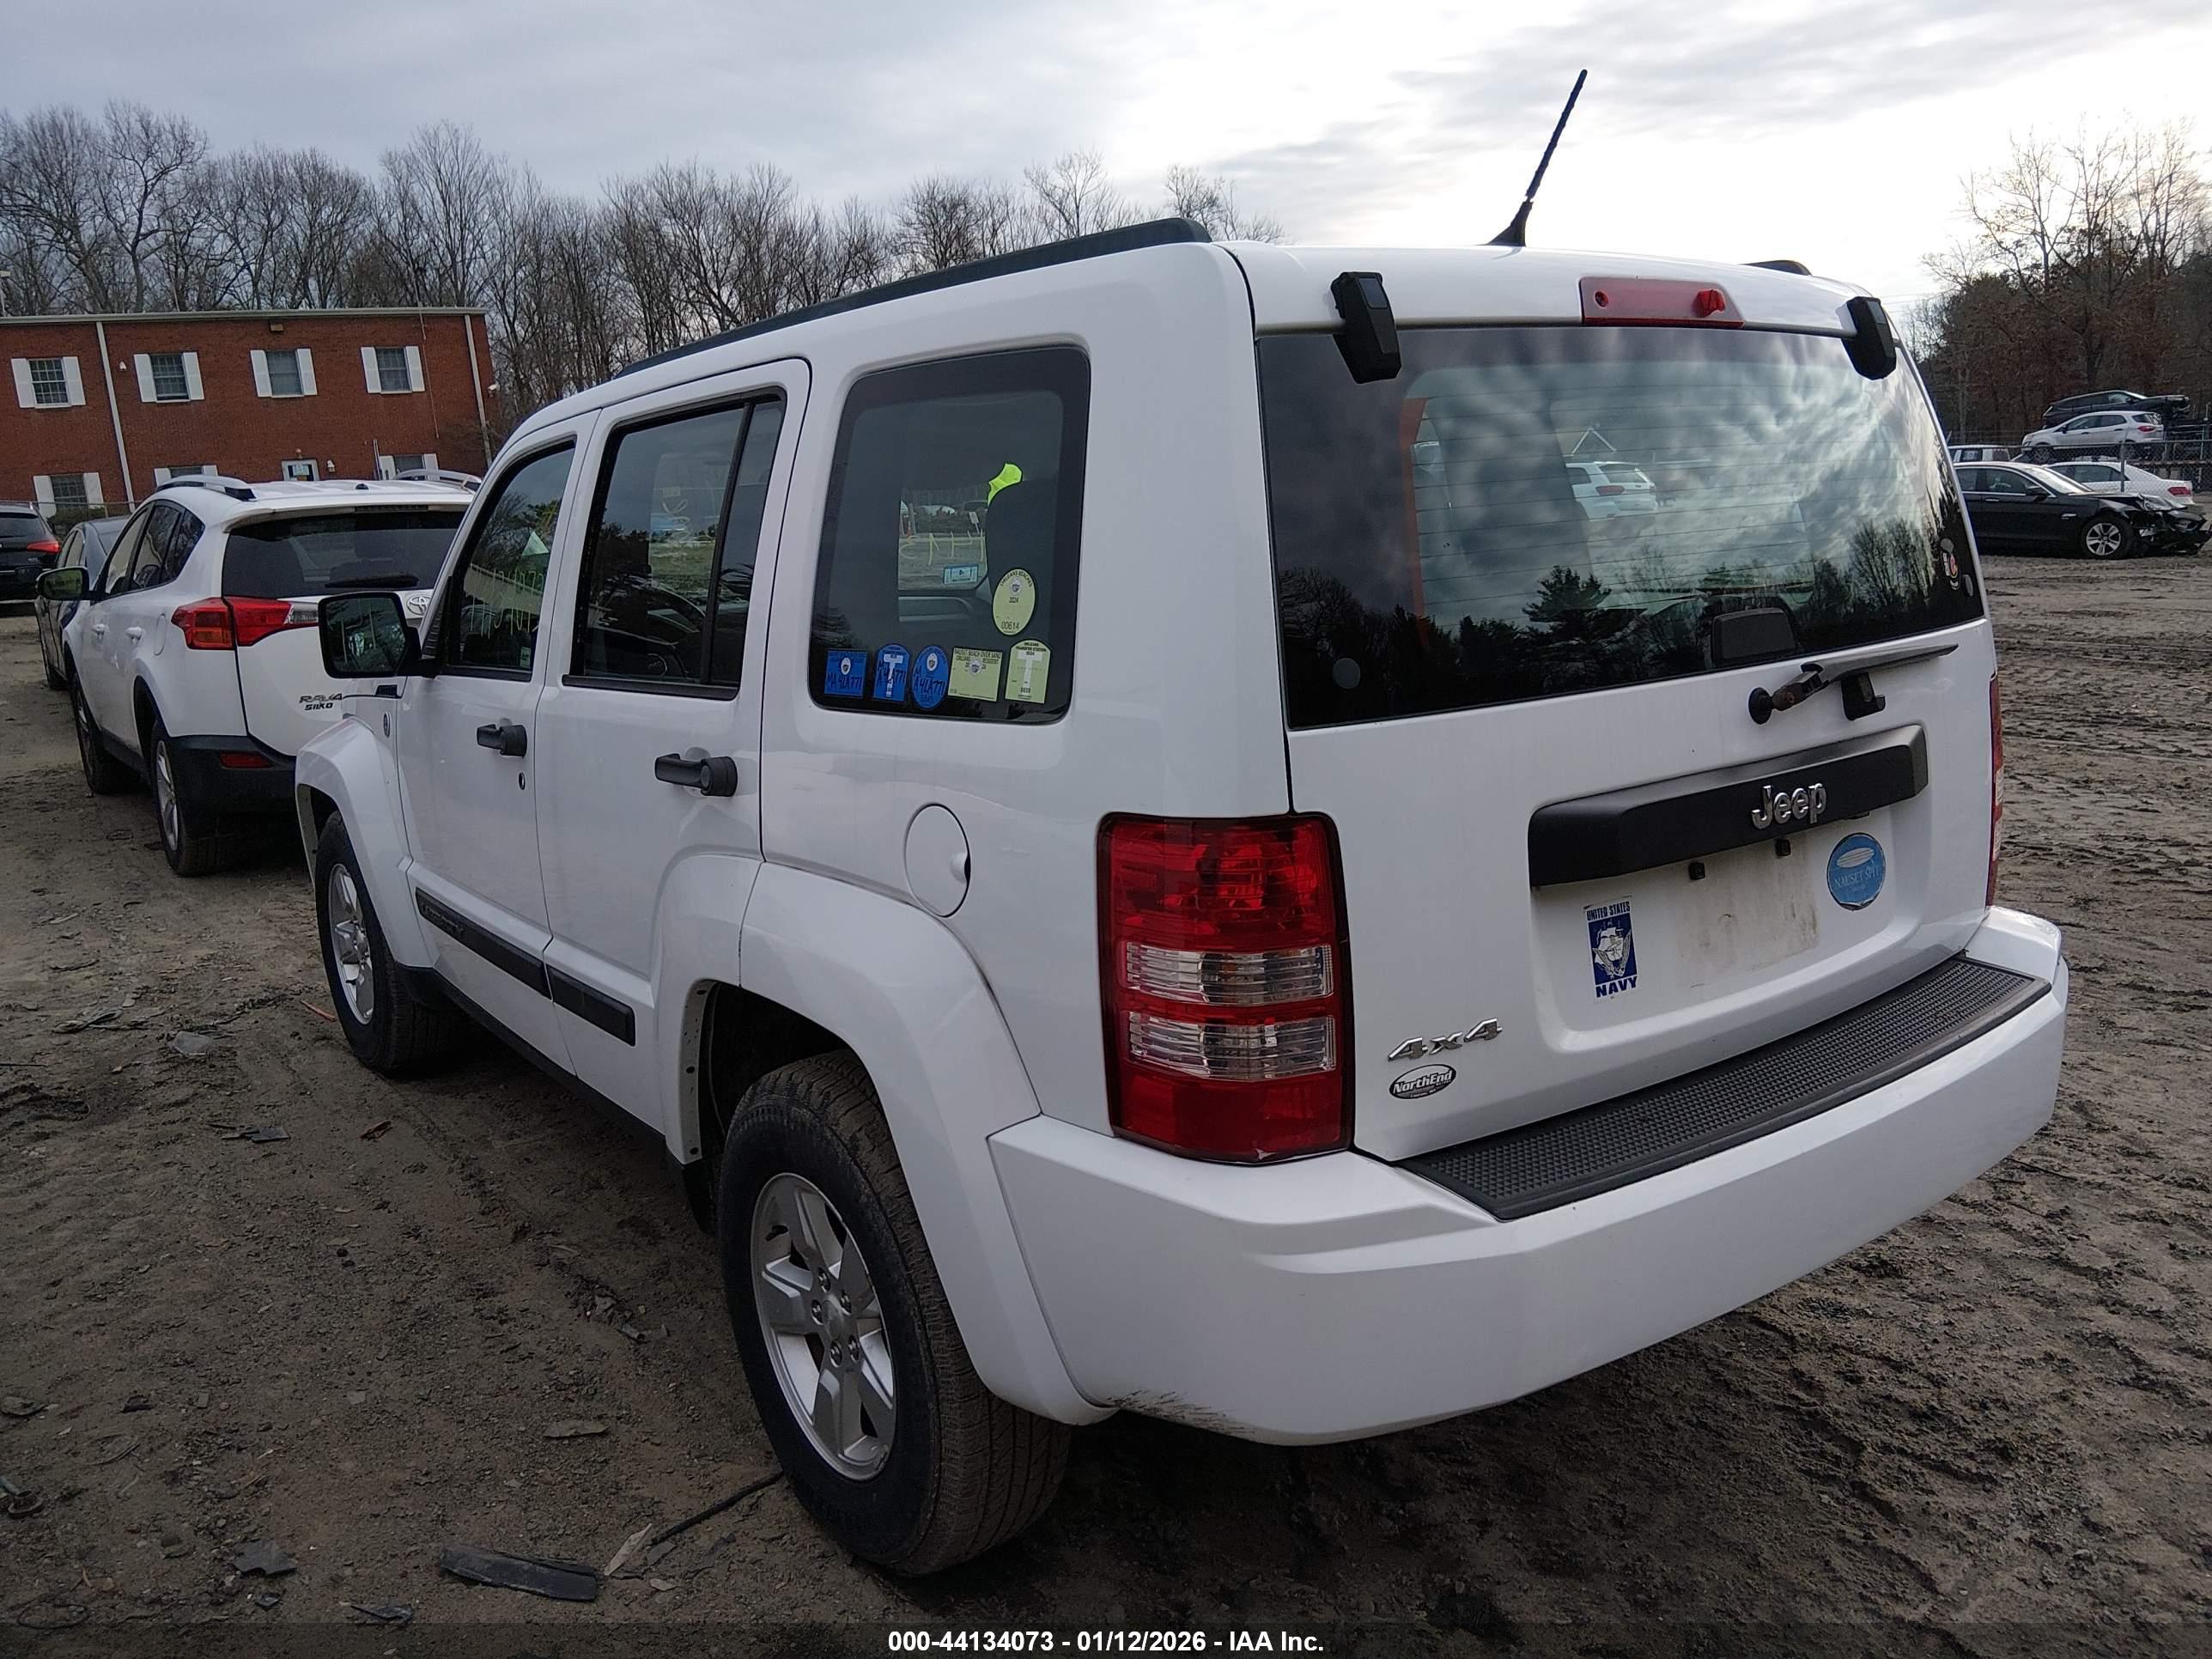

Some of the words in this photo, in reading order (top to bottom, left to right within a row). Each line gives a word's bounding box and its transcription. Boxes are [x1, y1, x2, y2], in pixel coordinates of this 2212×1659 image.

[304, 702, 334, 711] SILKO
[1751, 782, 1826, 830] Jeep
[1587, 906, 1608, 921] UNITED
[1608, 901, 1631, 915] STATES
[1595, 975, 1638, 999] NAVY
[1393, 1070, 1453, 1095] NorthEnd
